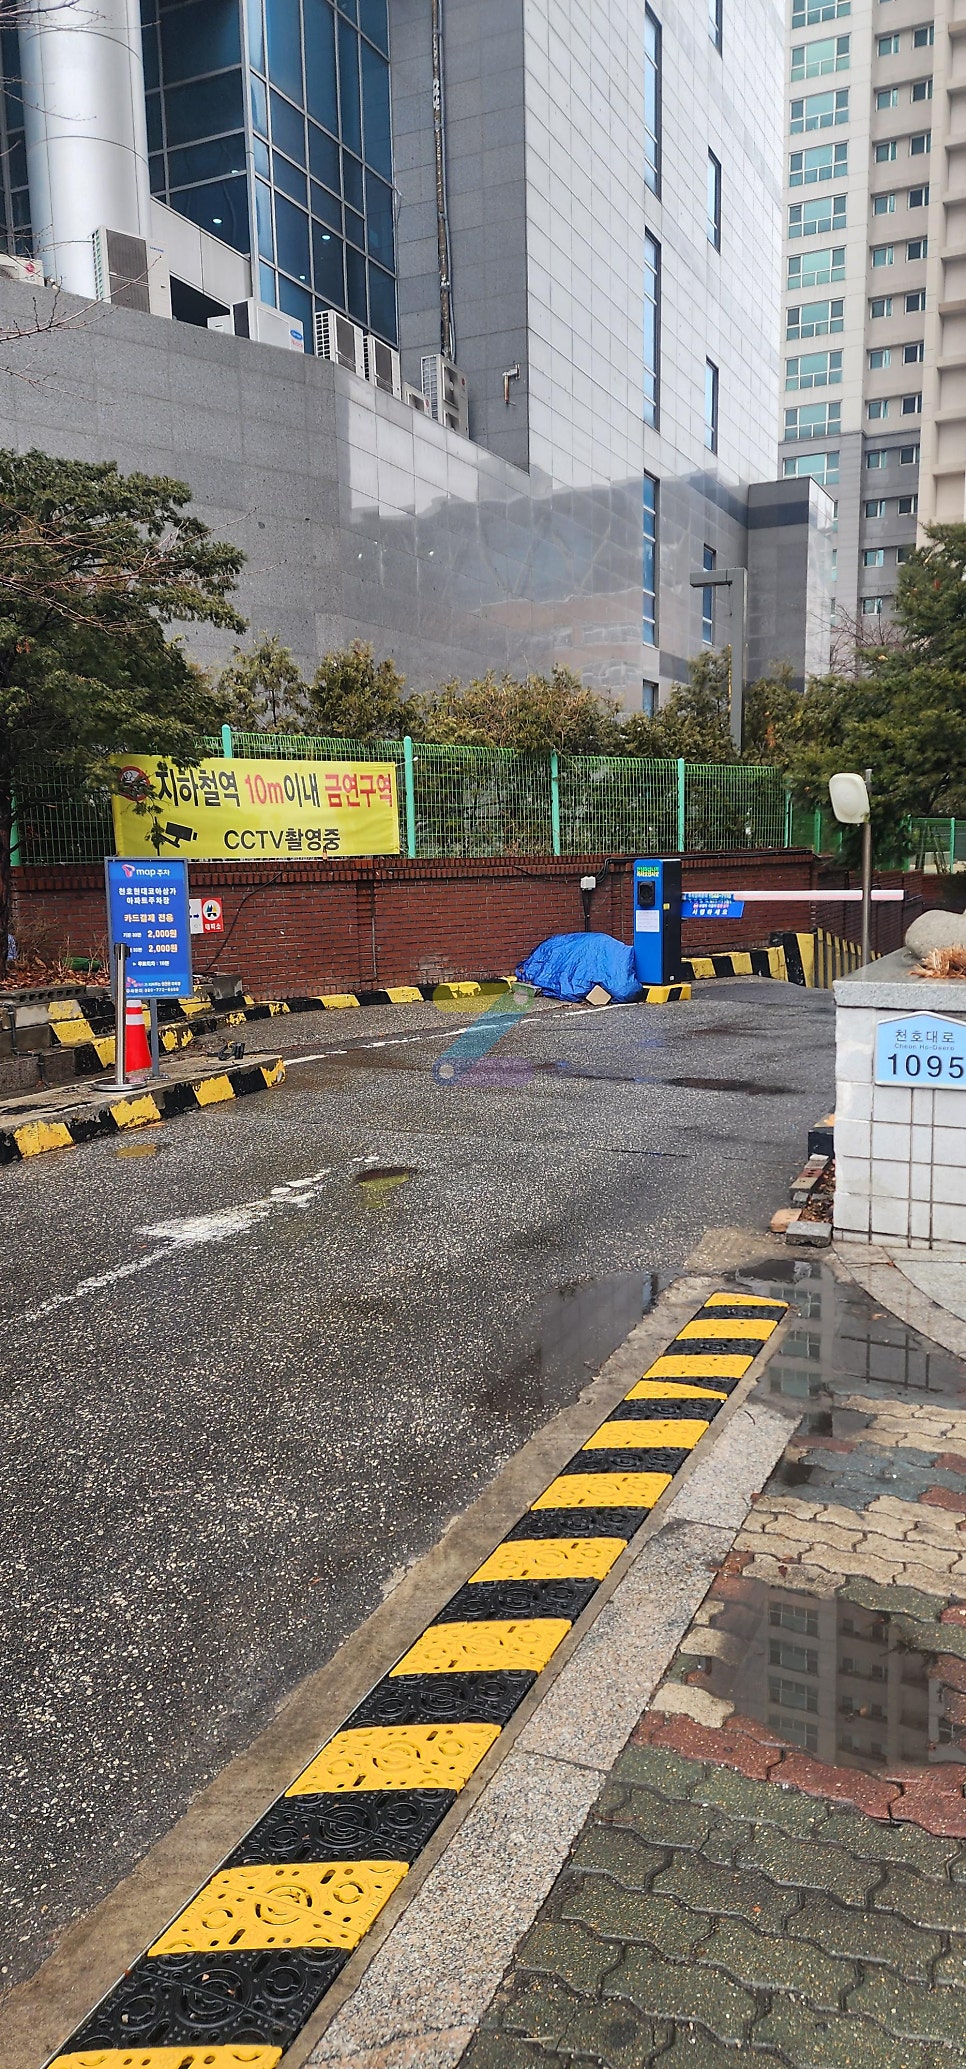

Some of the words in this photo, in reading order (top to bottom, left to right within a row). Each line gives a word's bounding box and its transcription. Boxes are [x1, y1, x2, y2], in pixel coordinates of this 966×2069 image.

[155, 768, 241, 808] 지하철역
[245, 772, 321, 808] 10m이내
[324, 773, 393, 808] 금연구역
[223, 826, 341, 851] CCTV촬영중
[124, 913, 155, 922] 카드결제
[158, 913, 174, 922] 전용
[147, 929, 177, 938] 2,000원
[148, 944, 178, 953] 2,000원
[895, 1029, 955, 1043] 천호대로
[887, 1053, 965, 1079] 1095
